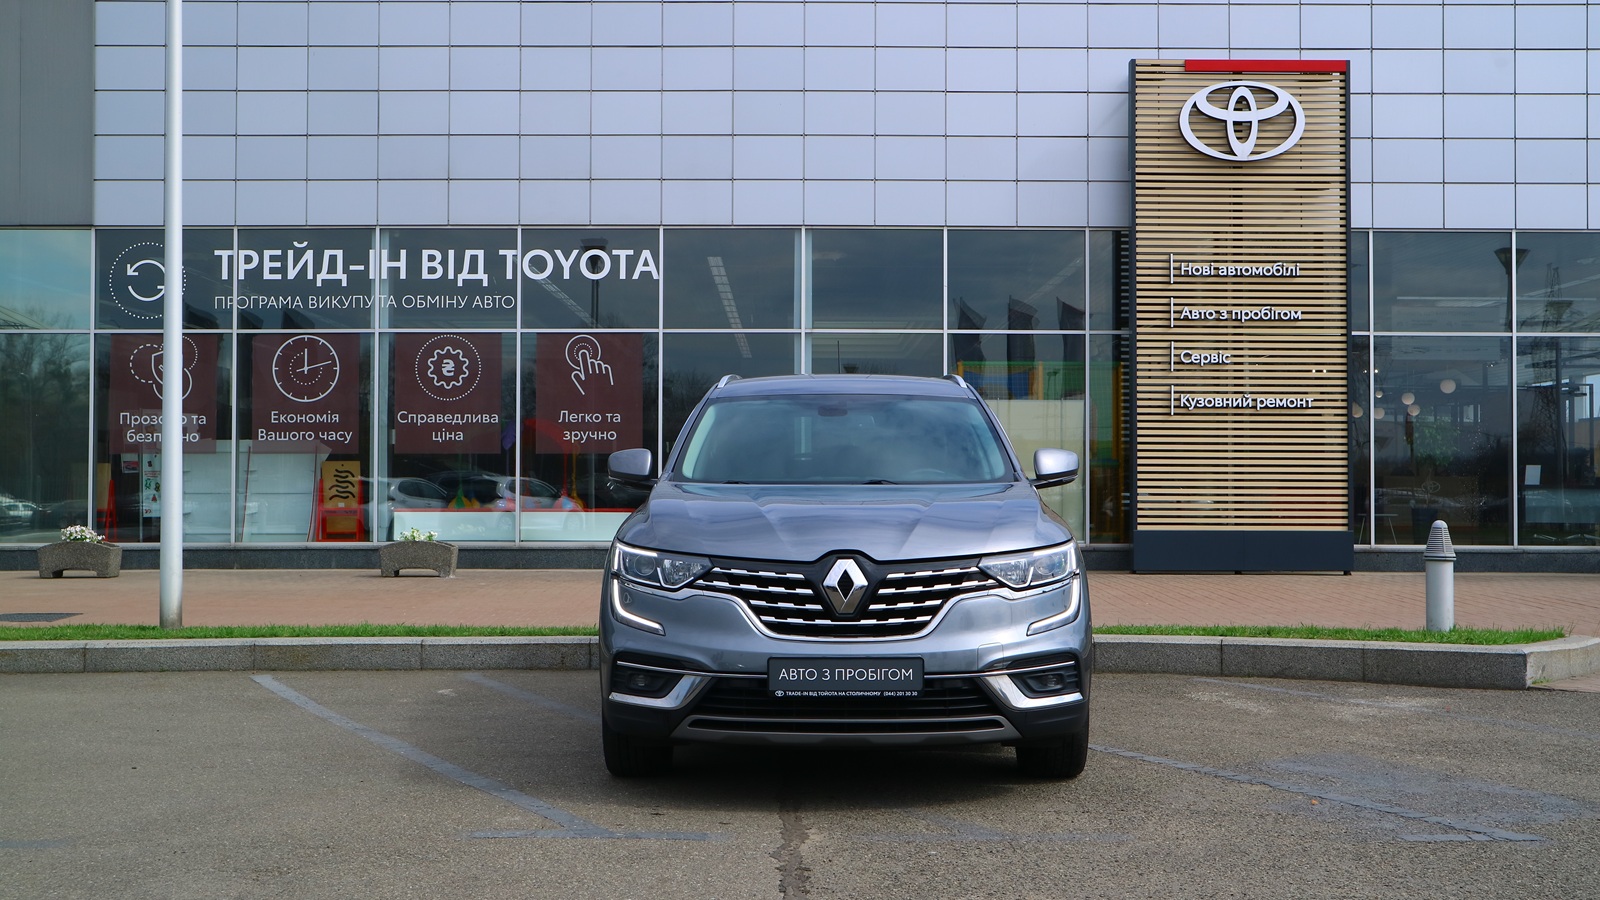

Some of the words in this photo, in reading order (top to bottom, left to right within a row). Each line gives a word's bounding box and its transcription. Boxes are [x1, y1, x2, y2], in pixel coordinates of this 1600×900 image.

[214, 241, 406, 287] ТРЕЙД-ІН
[421, 249, 488, 287] ВІД
[499, 249, 660, 280] TOYOTA
[1180, 262, 1214, 276] Нові
[1218, 262, 1300, 276] автомобілі
[214, 295, 303, 309] ПРОГРАМА
[308, 295, 375, 309] ВИКУПУ
[379, 295, 397, 309] ТА
[402, 295, 468, 309] ОБМІНУ
[472, 295, 515, 309] АВТО
[1180, 306, 1216, 320] Авто
[1219, 309, 1228, 320] з
[1232, 306, 1302, 323] пробігом
[1180, 350, 1231, 366] Сервіс
[1180, 394, 1252, 411] Кузовний
[1256, 397, 1314, 411] ремонт
[191, 415, 207, 425] та
[271, 410, 339, 424] Економія
[397, 410, 499, 426] Справедлива
[558, 410, 601, 423] Легко
[605, 413, 621, 423] та
[126, 429, 199, 443] безпно
[258, 428, 314, 441] Вашого
[319, 430, 353, 444] часу
[432, 429, 464, 443] ціна
[563, 430, 617, 443] зручно
[778, 668, 818, 681] АВТО
[821, 668, 831, 681] З
[835, 668, 913, 681] ПРОБІГОМ
